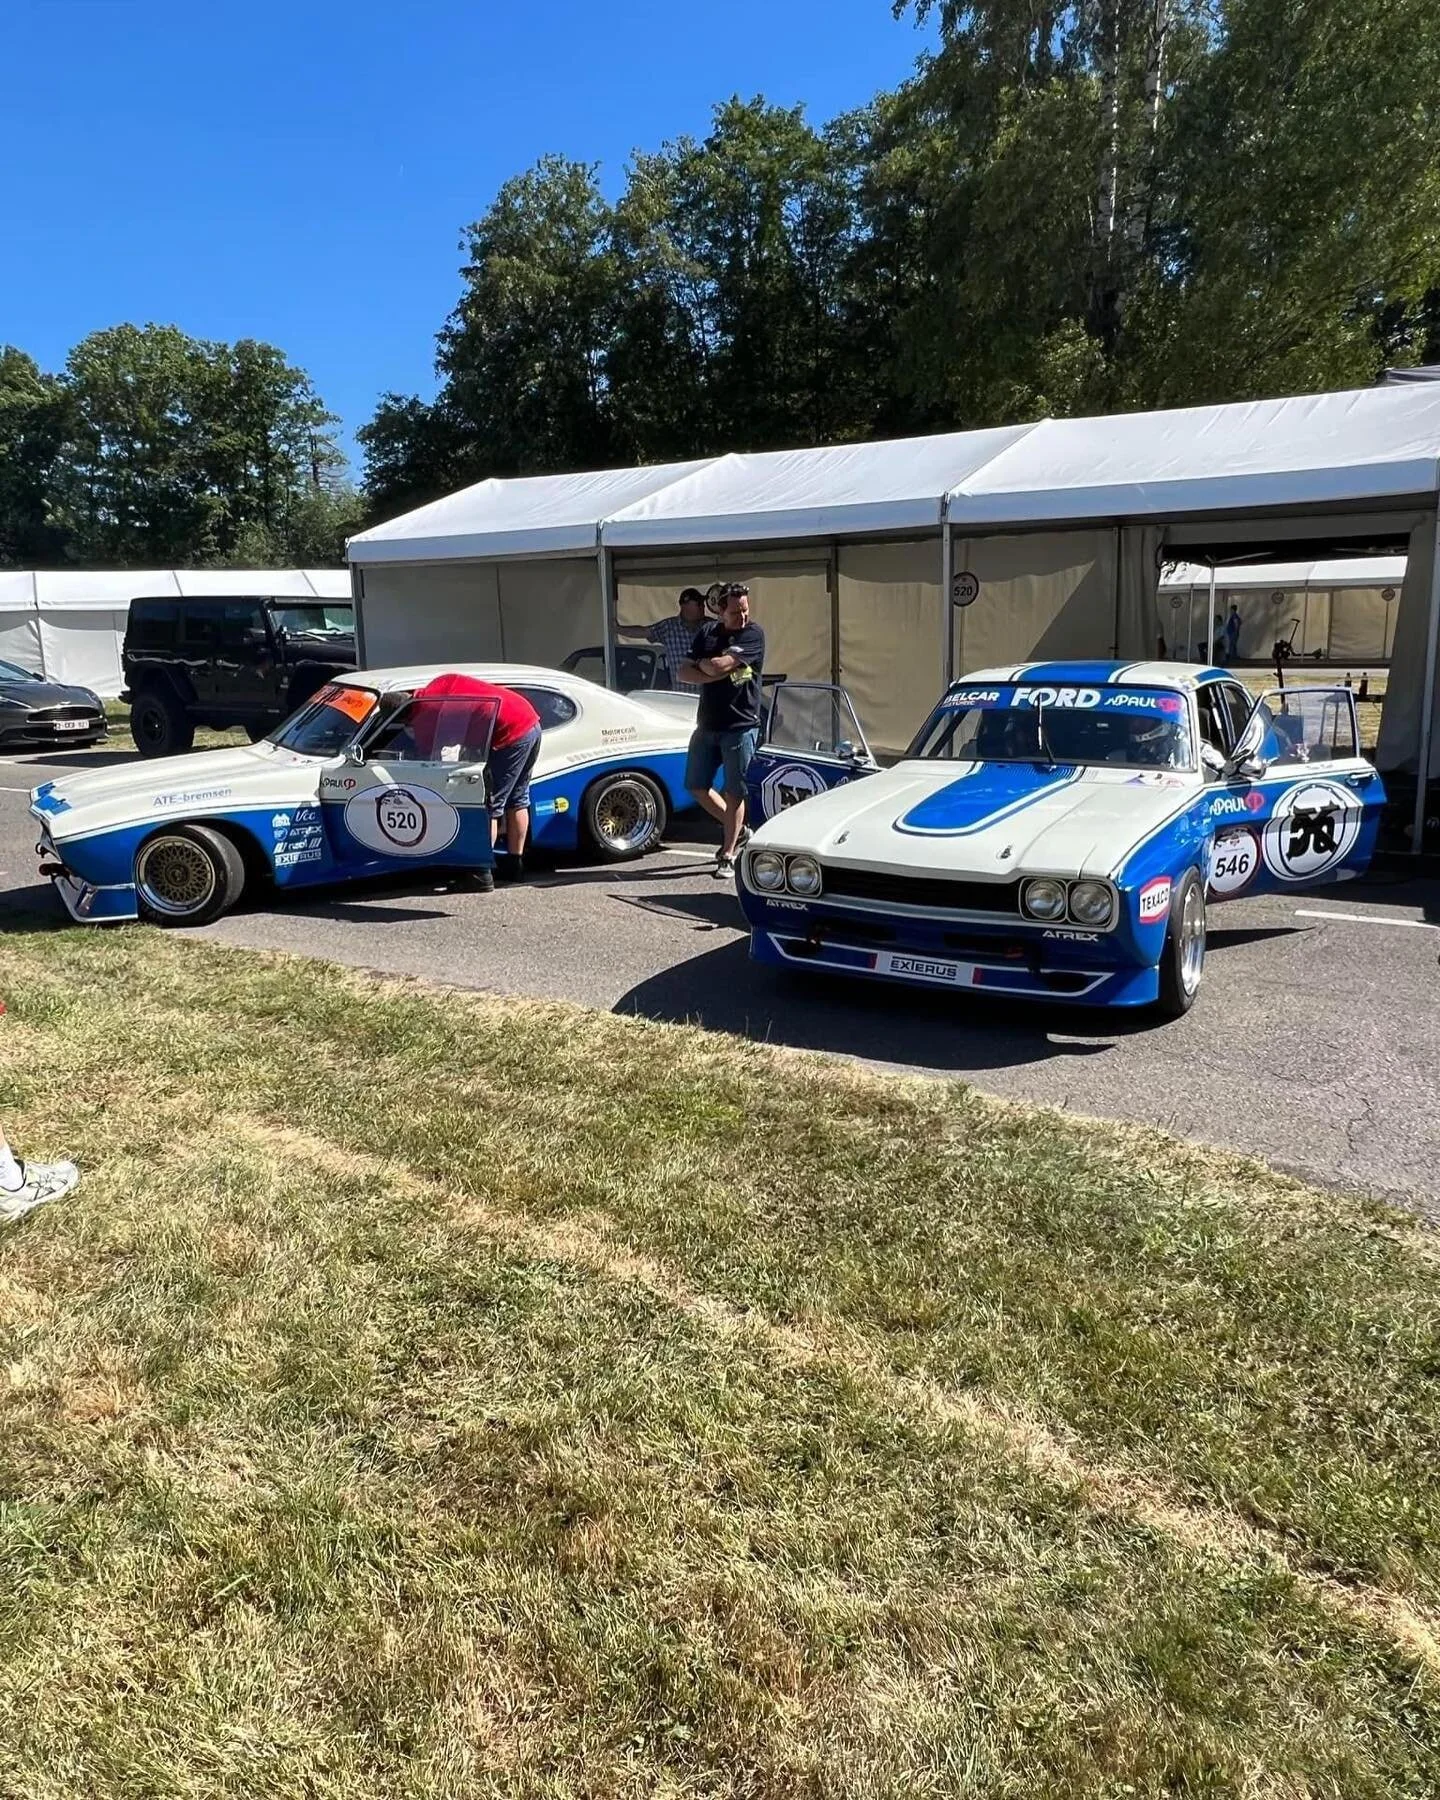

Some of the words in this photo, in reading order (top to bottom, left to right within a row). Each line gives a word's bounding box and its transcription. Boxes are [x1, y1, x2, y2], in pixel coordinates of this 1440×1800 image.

[954, 586, 972, 596] 520
[1010, 687, 1101, 708] FORD
[387, 812, 417, 829] 520
[1215, 853, 1250, 878] 546
[766, 898, 809, 911] ATREX
[1142, 887, 1169, 913] TEXACO
[1042, 930, 1099, 942] ATREX
[890, 957, 957, 979] EXTERUS
